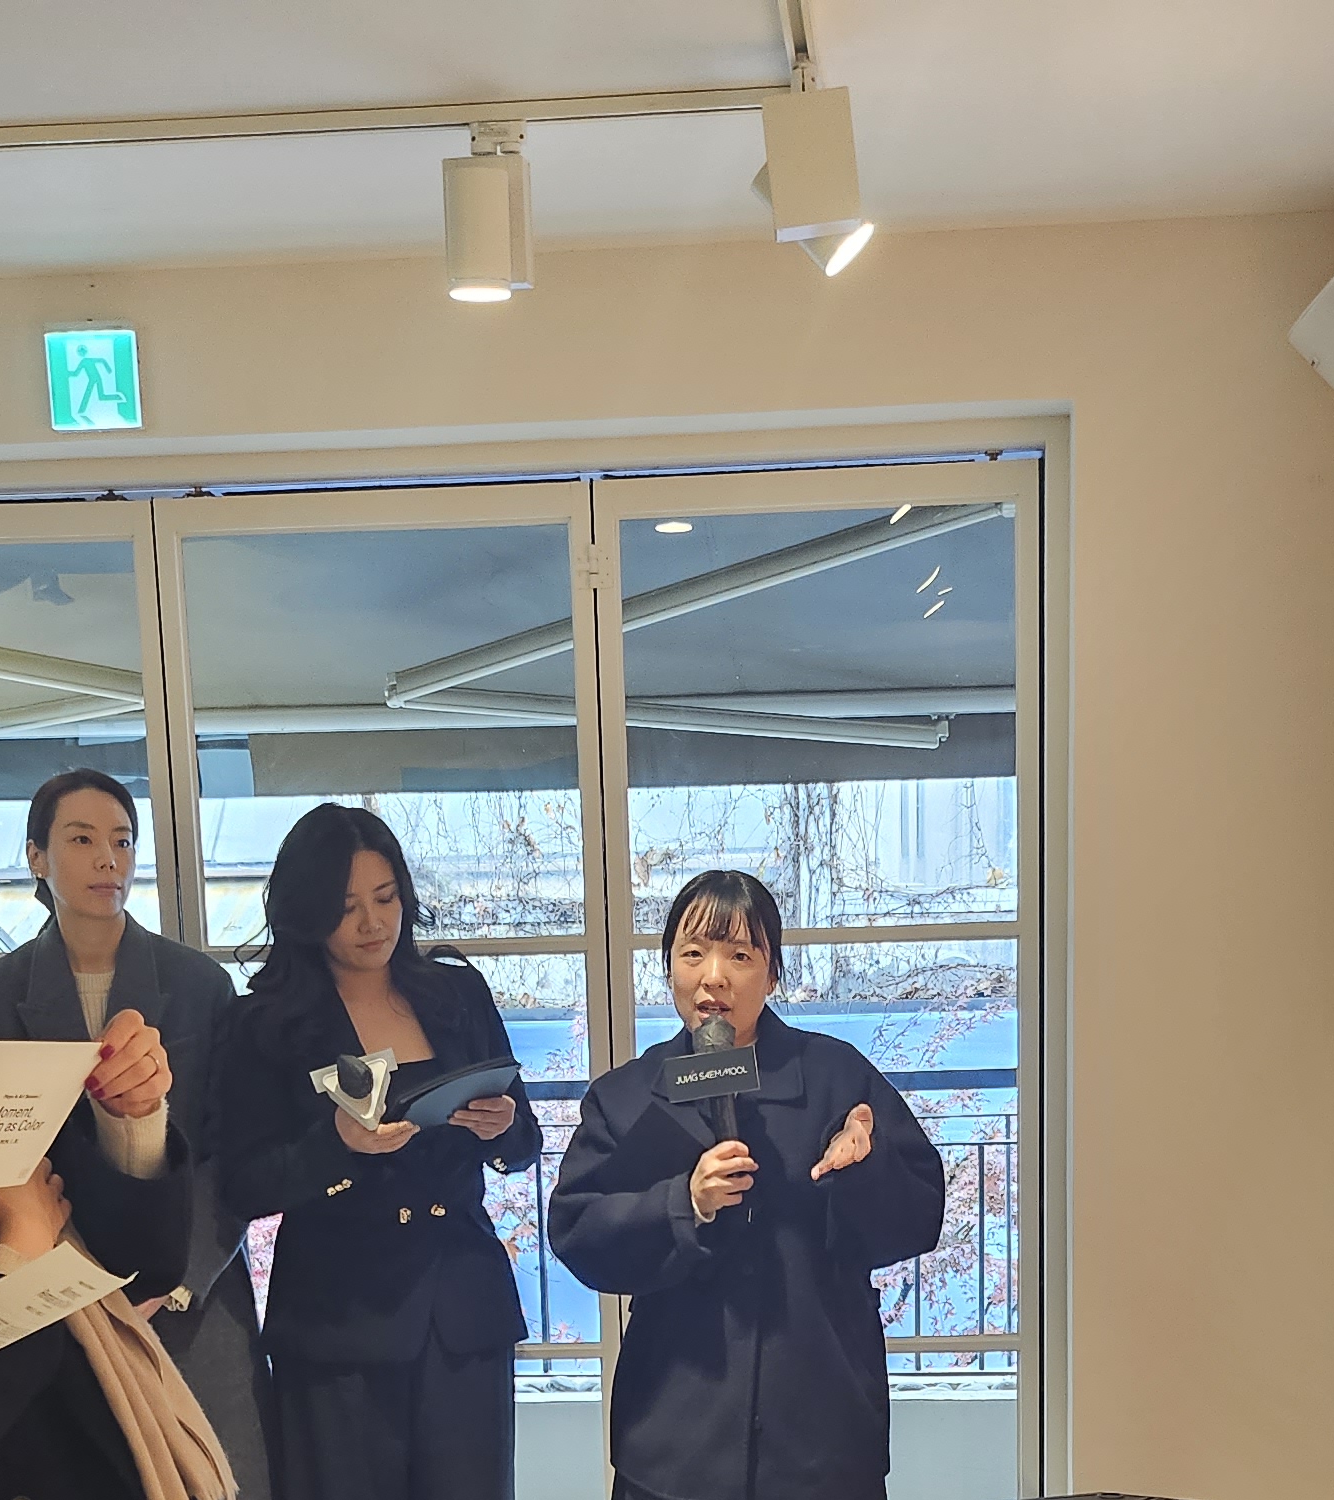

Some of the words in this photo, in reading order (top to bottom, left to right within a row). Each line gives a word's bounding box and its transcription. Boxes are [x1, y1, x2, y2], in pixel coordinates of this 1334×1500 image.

[675, 1073, 698, 1085] JUNG
[4, 1122, 17, 1132] as
[18, 1119, 45, 1132] Color
